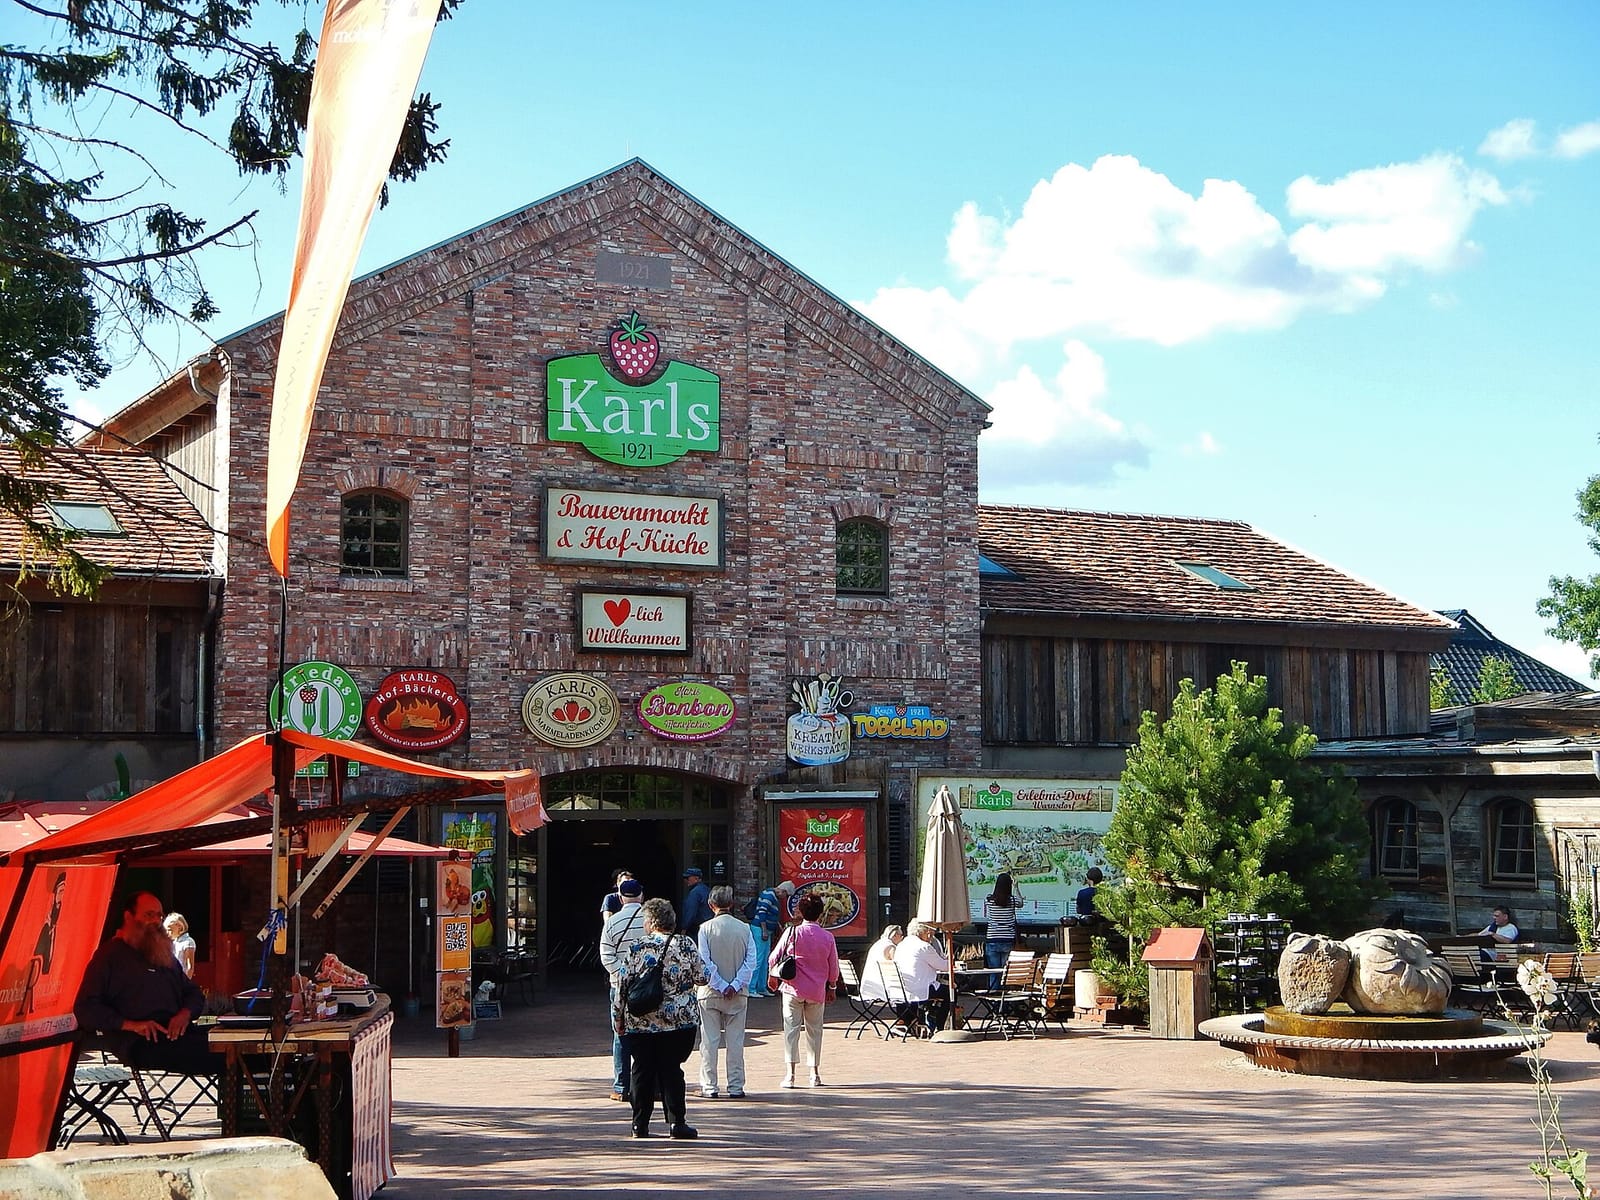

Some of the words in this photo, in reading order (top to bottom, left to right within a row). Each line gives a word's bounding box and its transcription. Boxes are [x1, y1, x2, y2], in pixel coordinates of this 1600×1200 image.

[620, 261, 649, 279] 1921
[557, 378, 710, 441] Karls
[621, 442, 653, 460] 1921
[557, 493, 710, 526] Bauernmarkt
[557, 529, 573, 548] &
[580, 526, 710, 558] Hof-Küche
[586, 627, 681, 646] Willkommen
[400, 673, 438, 683] KARLS
[376, 684, 459, 706] Hof-Bäckerei
[545, 680, 598, 698] KARLS
[645, 694, 732, 717] Bonbon
[910, 708, 924, 716] 1921
[794, 729, 843, 744] KREATIV
[790, 741, 847, 755] WERKSTATT
[313, 764, 325, 774] ist
[979, 794, 1011, 806] Karls
[1016, 789, 1093, 804] Erlebnis-Dorf
[461, 822, 481, 833] Karls
[809, 822, 839, 833] Karls
[785, 837, 860, 853] Schnitzel
[800, 854, 845, 870] Essen
